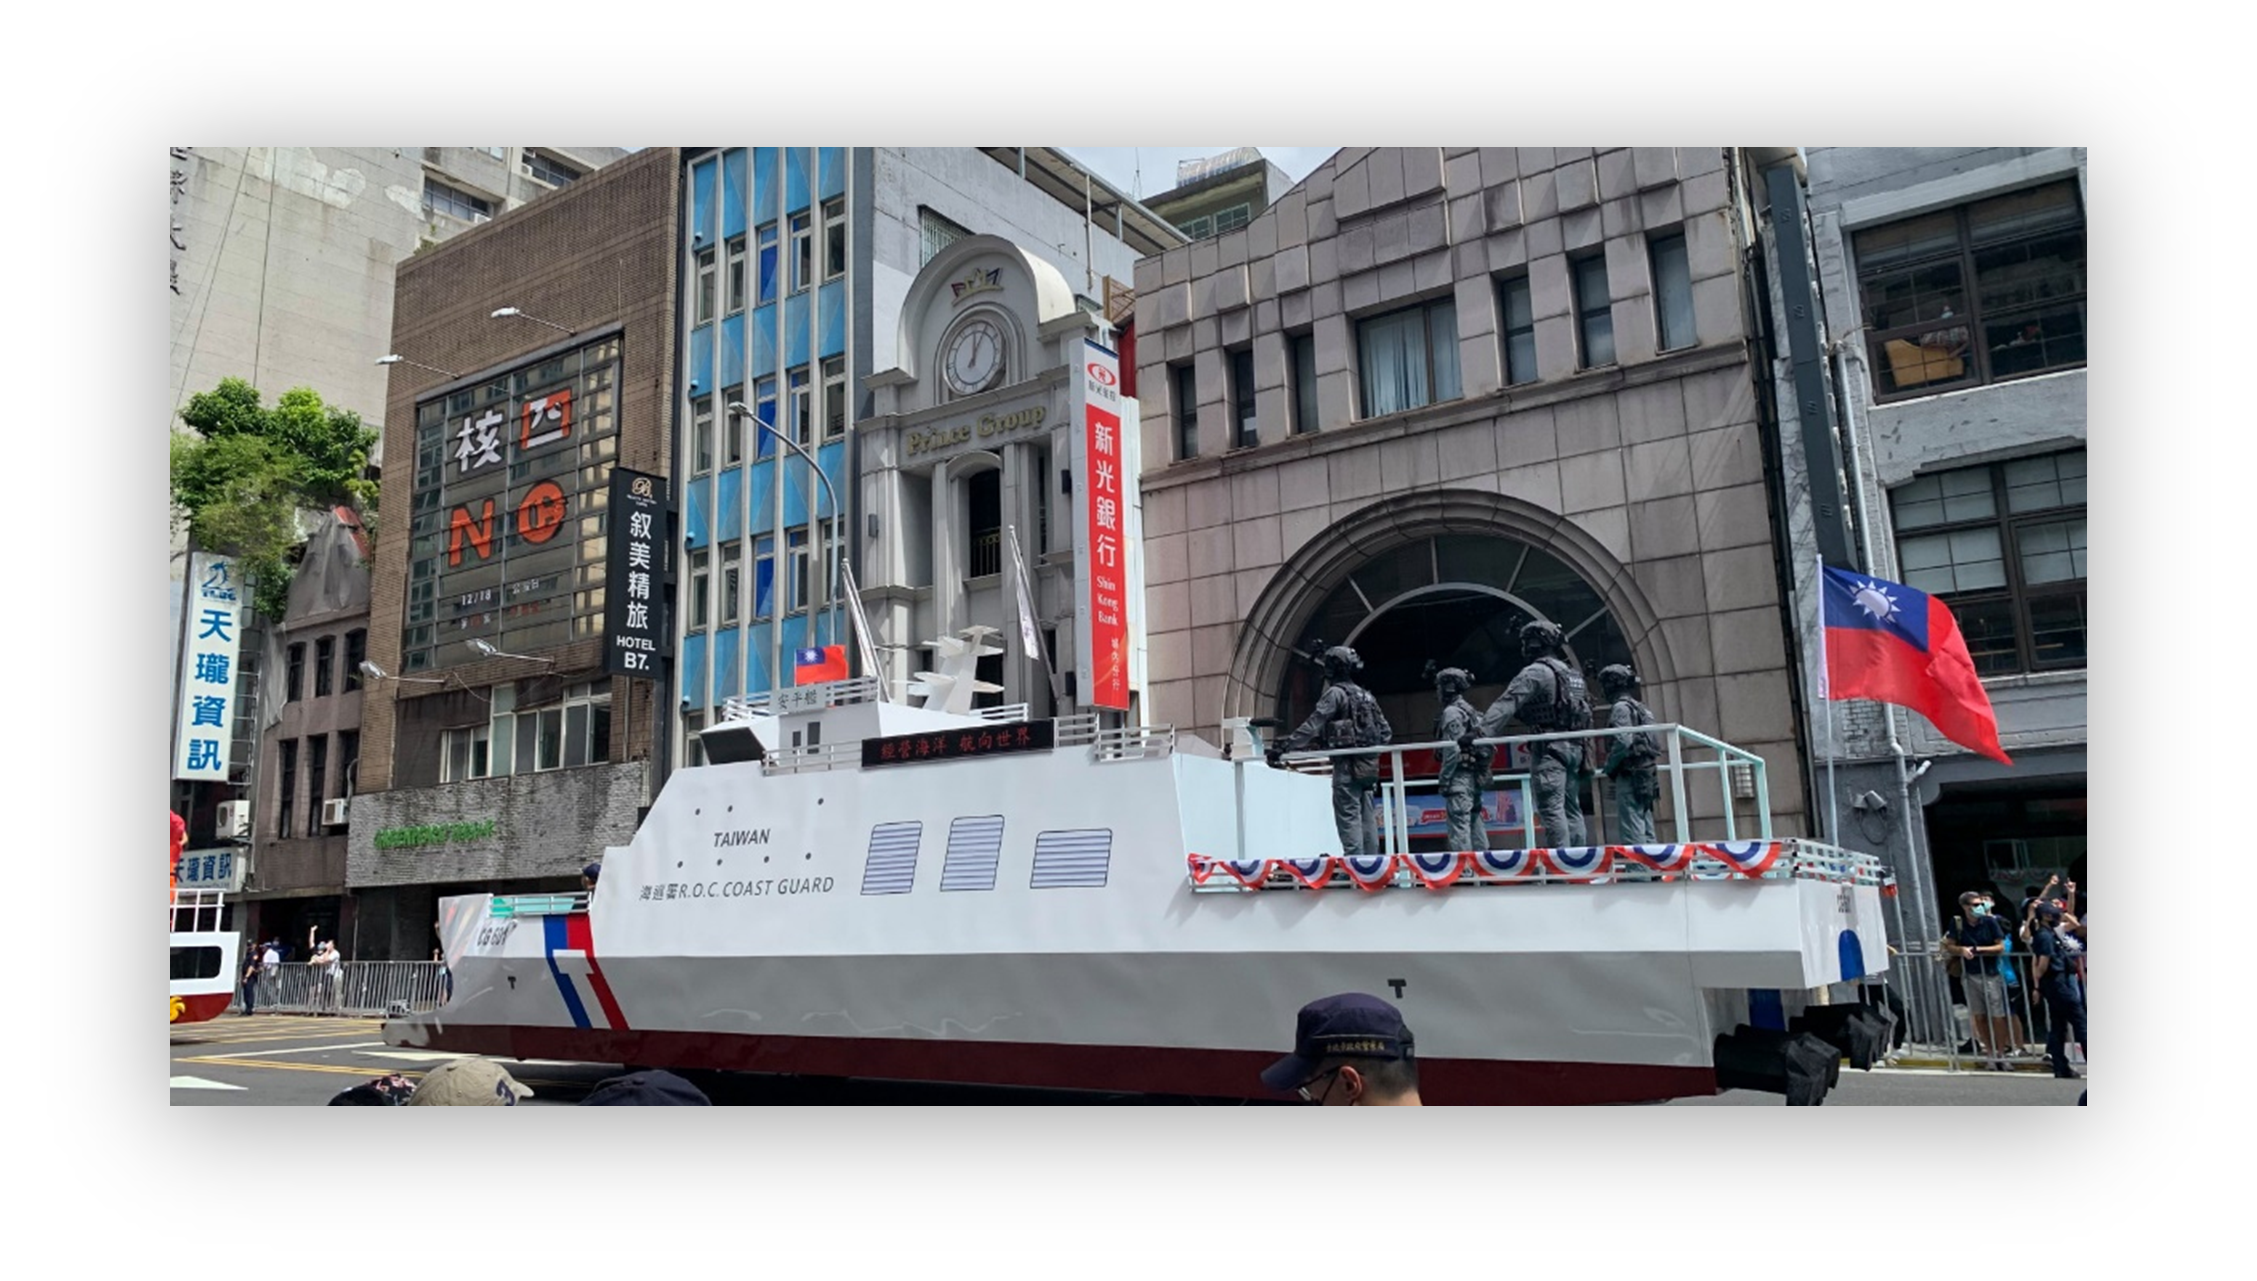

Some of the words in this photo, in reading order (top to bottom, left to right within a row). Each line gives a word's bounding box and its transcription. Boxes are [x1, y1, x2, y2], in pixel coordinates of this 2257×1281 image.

[454, 388, 573, 473] 核四
[907, 425, 971, 456] Prince
[977, 405, 1046, 437] Group
[1094, 421, 1117, 568] 新光銀行
[1096, 575, 1117, 592] Shin
[461, 588, 492, 606] 12/18
[1097, 593, 1119, 612] Kong
[1098, 610, 1119, 627] Bank
[616, 634, 656, 652] HOTEL
[186, 608, 234, 772] 天瓏資訊
[880, 735, 948, 761] 經營海洋
[959, 726, 1032, 753] 航向世界
[713, 828, 771, 848] TAIWAN
[722, 879, 774, 898] COAST
[777, 876, 835, 895] GUARD
